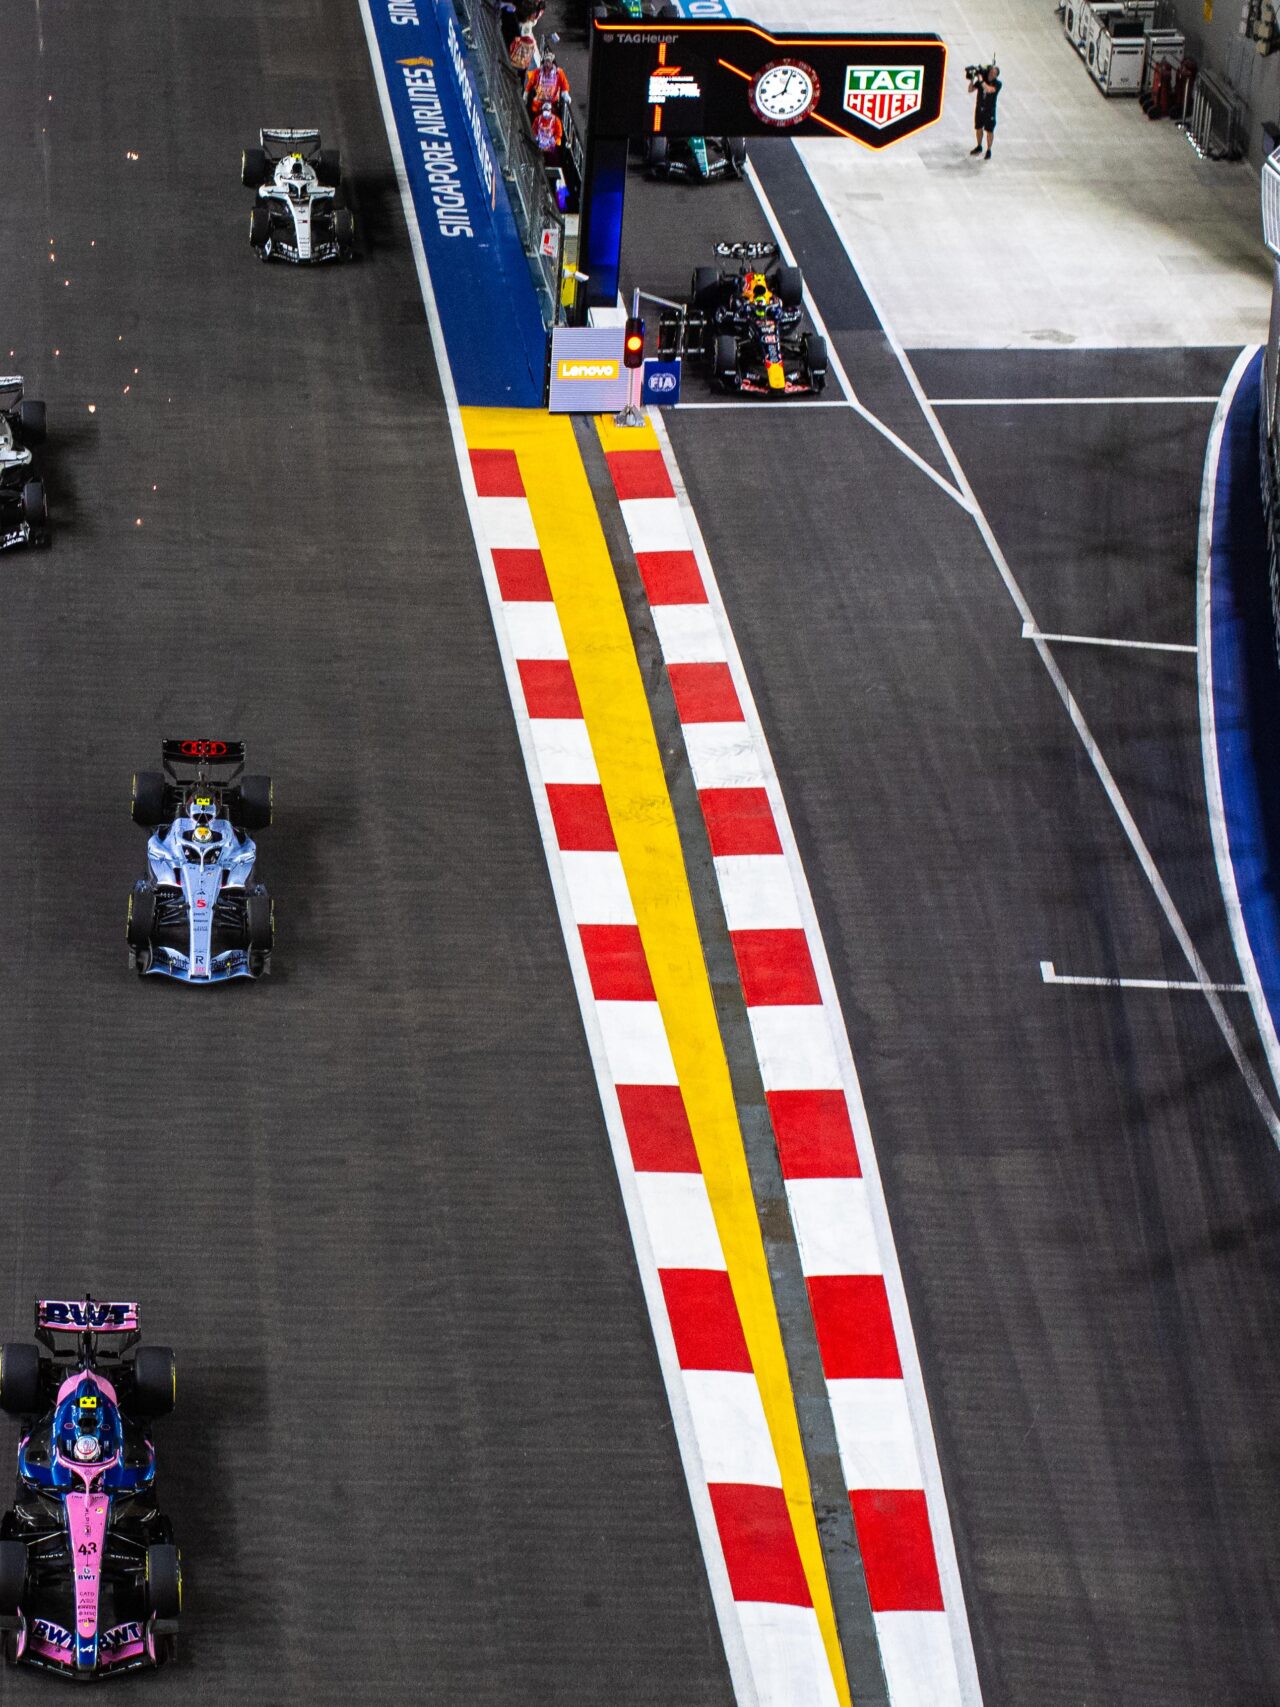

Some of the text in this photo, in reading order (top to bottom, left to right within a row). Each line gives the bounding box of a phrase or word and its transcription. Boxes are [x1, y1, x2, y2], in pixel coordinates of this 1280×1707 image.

[853, 71, 916, 90] TAG
[849, 93, 918, 125] HEUER
[403, 67, 474, 238] SINGAPORE AIRLINES
[562, 363, 614, 377] Lenovo
[649, 376, 675, 389] FIA
[196, 899, 207, 909] 5
[45, 1302, 132, 1326] BWT
[78, 1541, 97, 1556] 43
